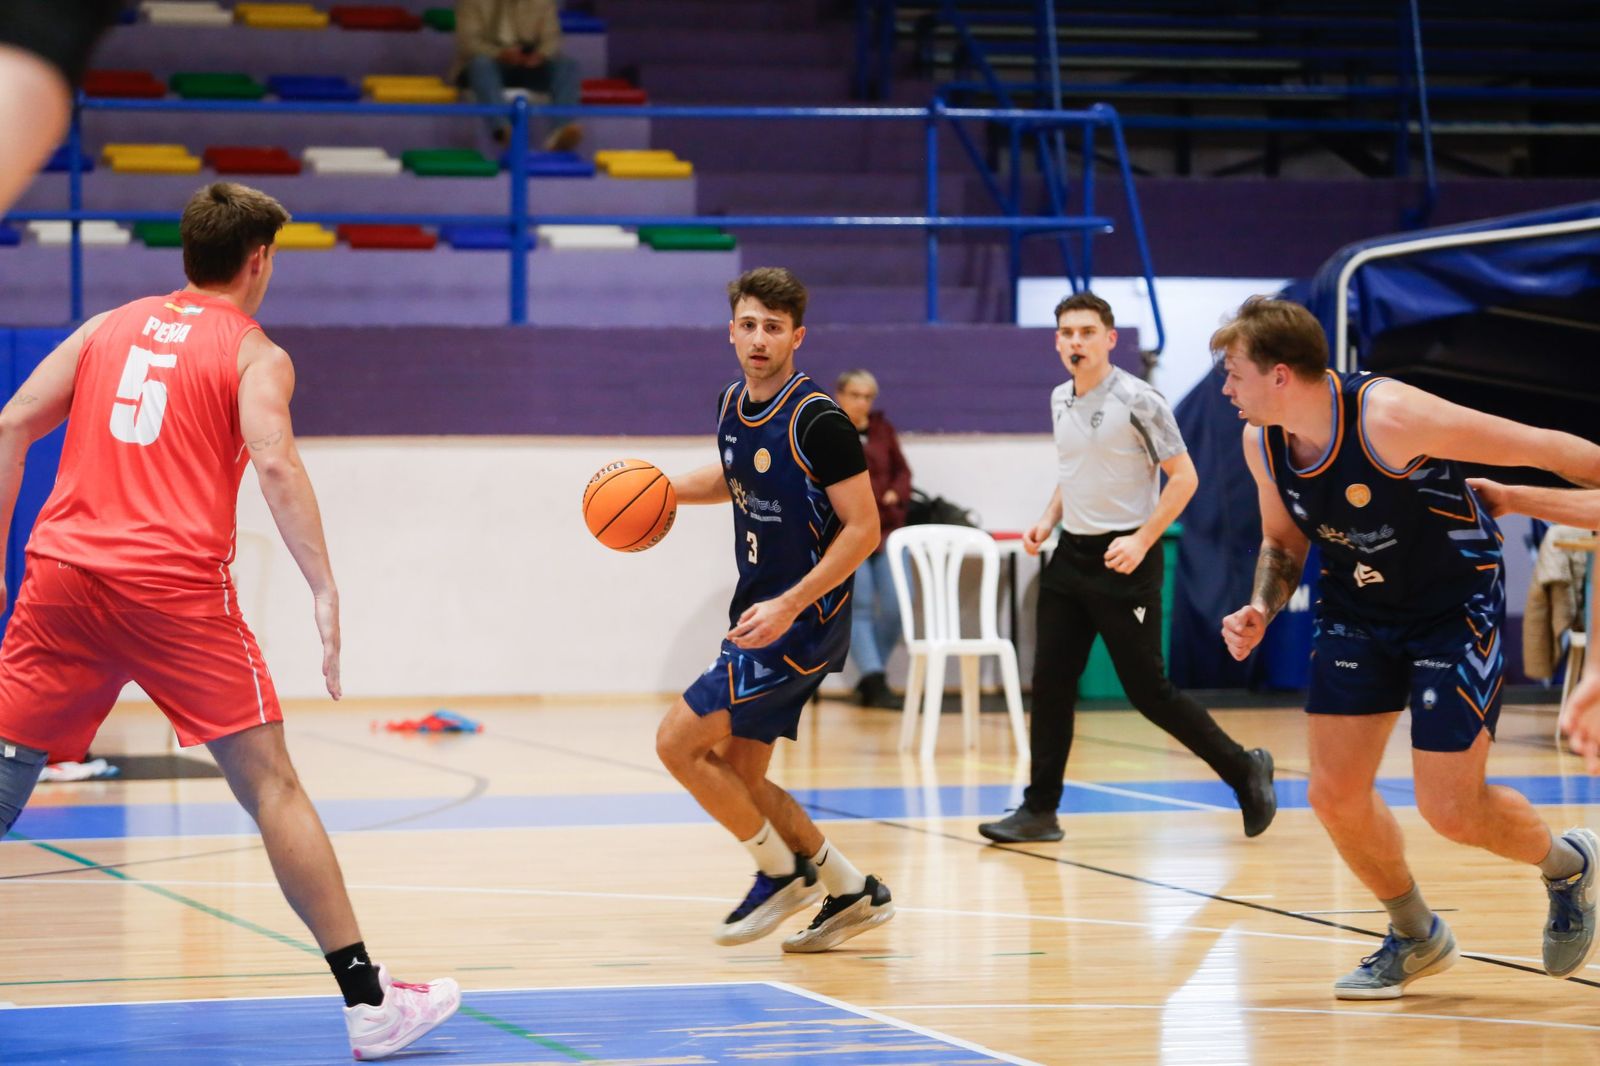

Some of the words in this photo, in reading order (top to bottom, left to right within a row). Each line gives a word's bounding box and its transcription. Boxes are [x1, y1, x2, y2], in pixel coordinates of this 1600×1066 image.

[142, 315, 192, 343] PEÑA
[109, 344, 178, 446] 5
[746, 530, 758, 565] 3
[1334, 660, 1359, 669] vive
